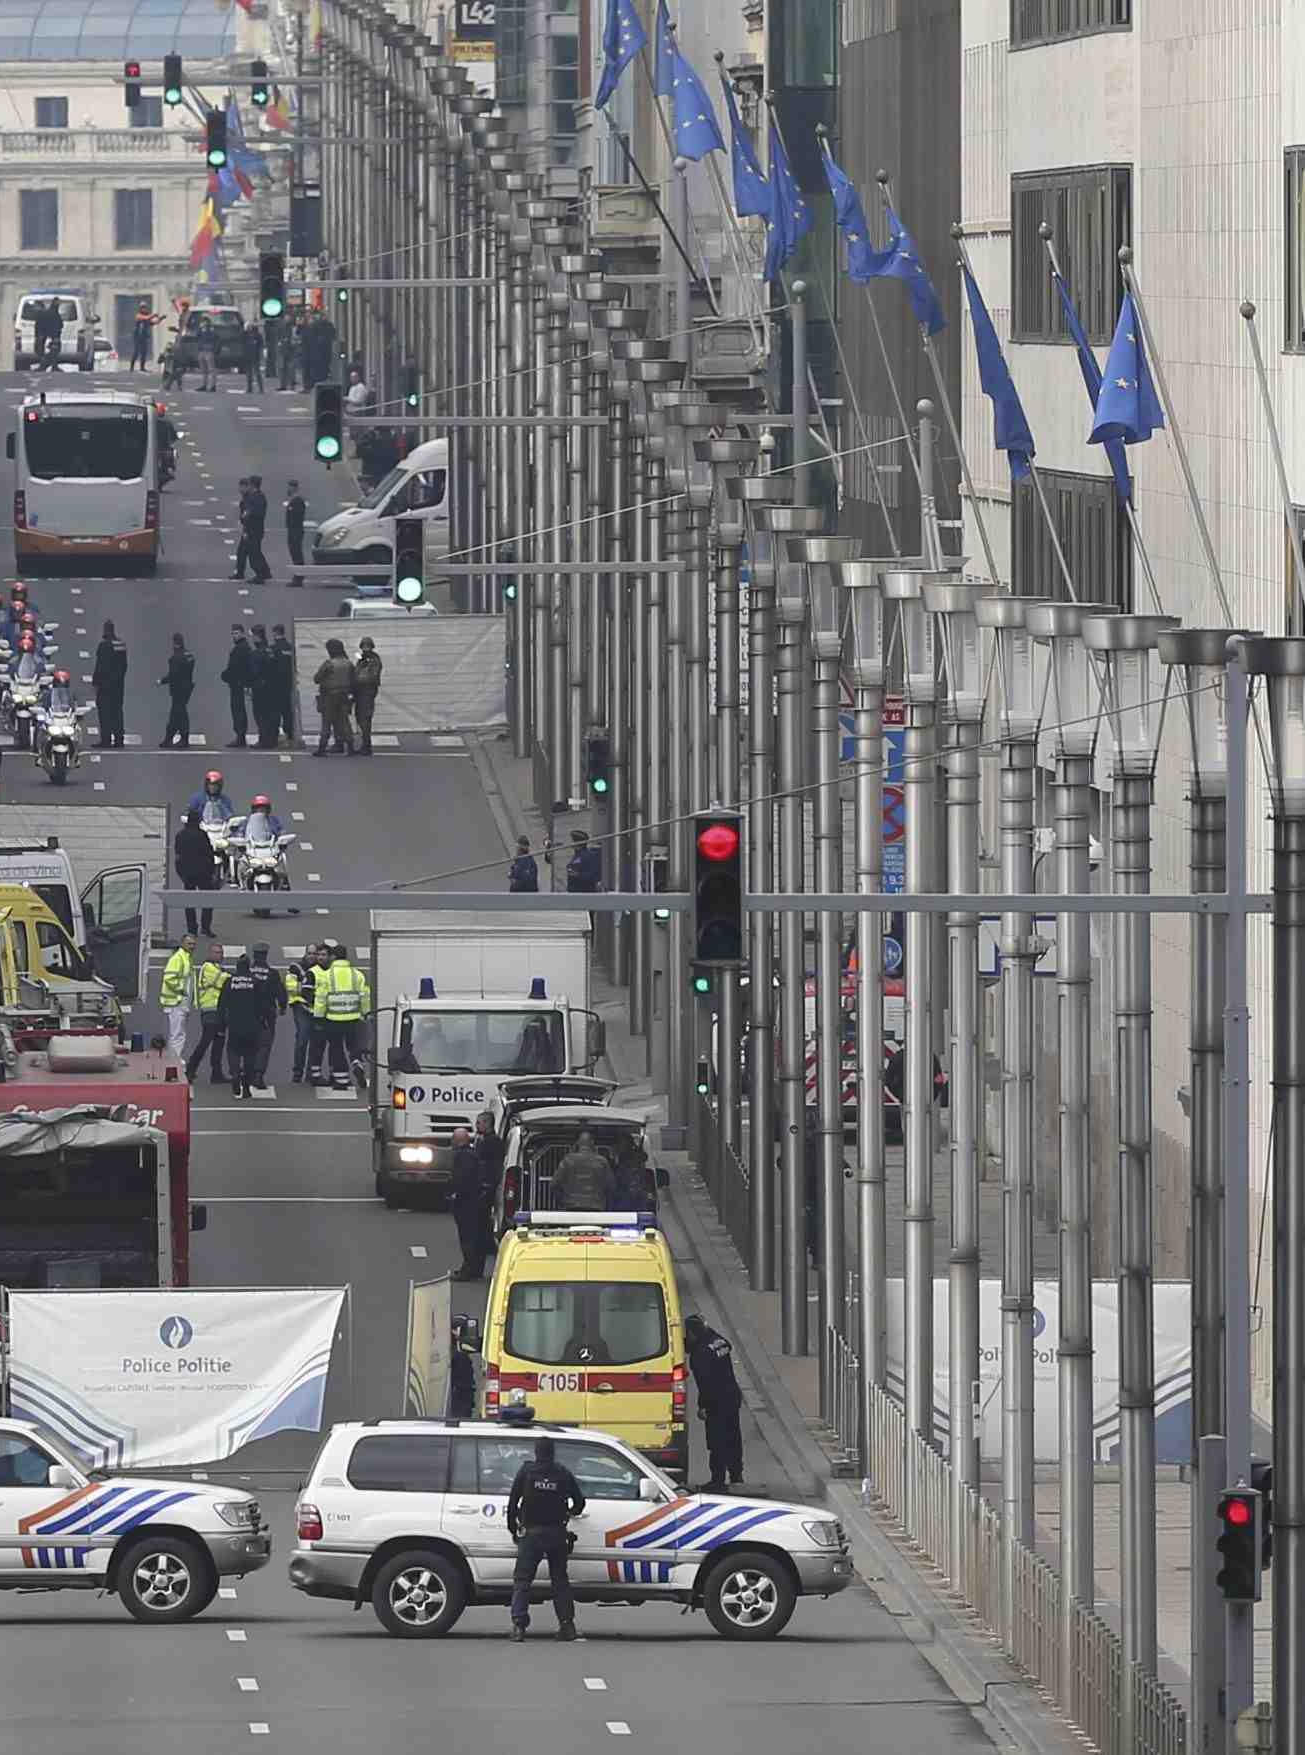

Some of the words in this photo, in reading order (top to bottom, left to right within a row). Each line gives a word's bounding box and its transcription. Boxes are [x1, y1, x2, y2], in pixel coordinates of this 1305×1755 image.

[461, 1, 496, 24] L42
[432, 1087, 484, 1102] Police
[122, 1358, 172, 1373] Police
[178, 1357, 232, 1373] Politie
[549, 1373, 577, 1391] 105
[534, 1481, 557, 1490] POLICE
